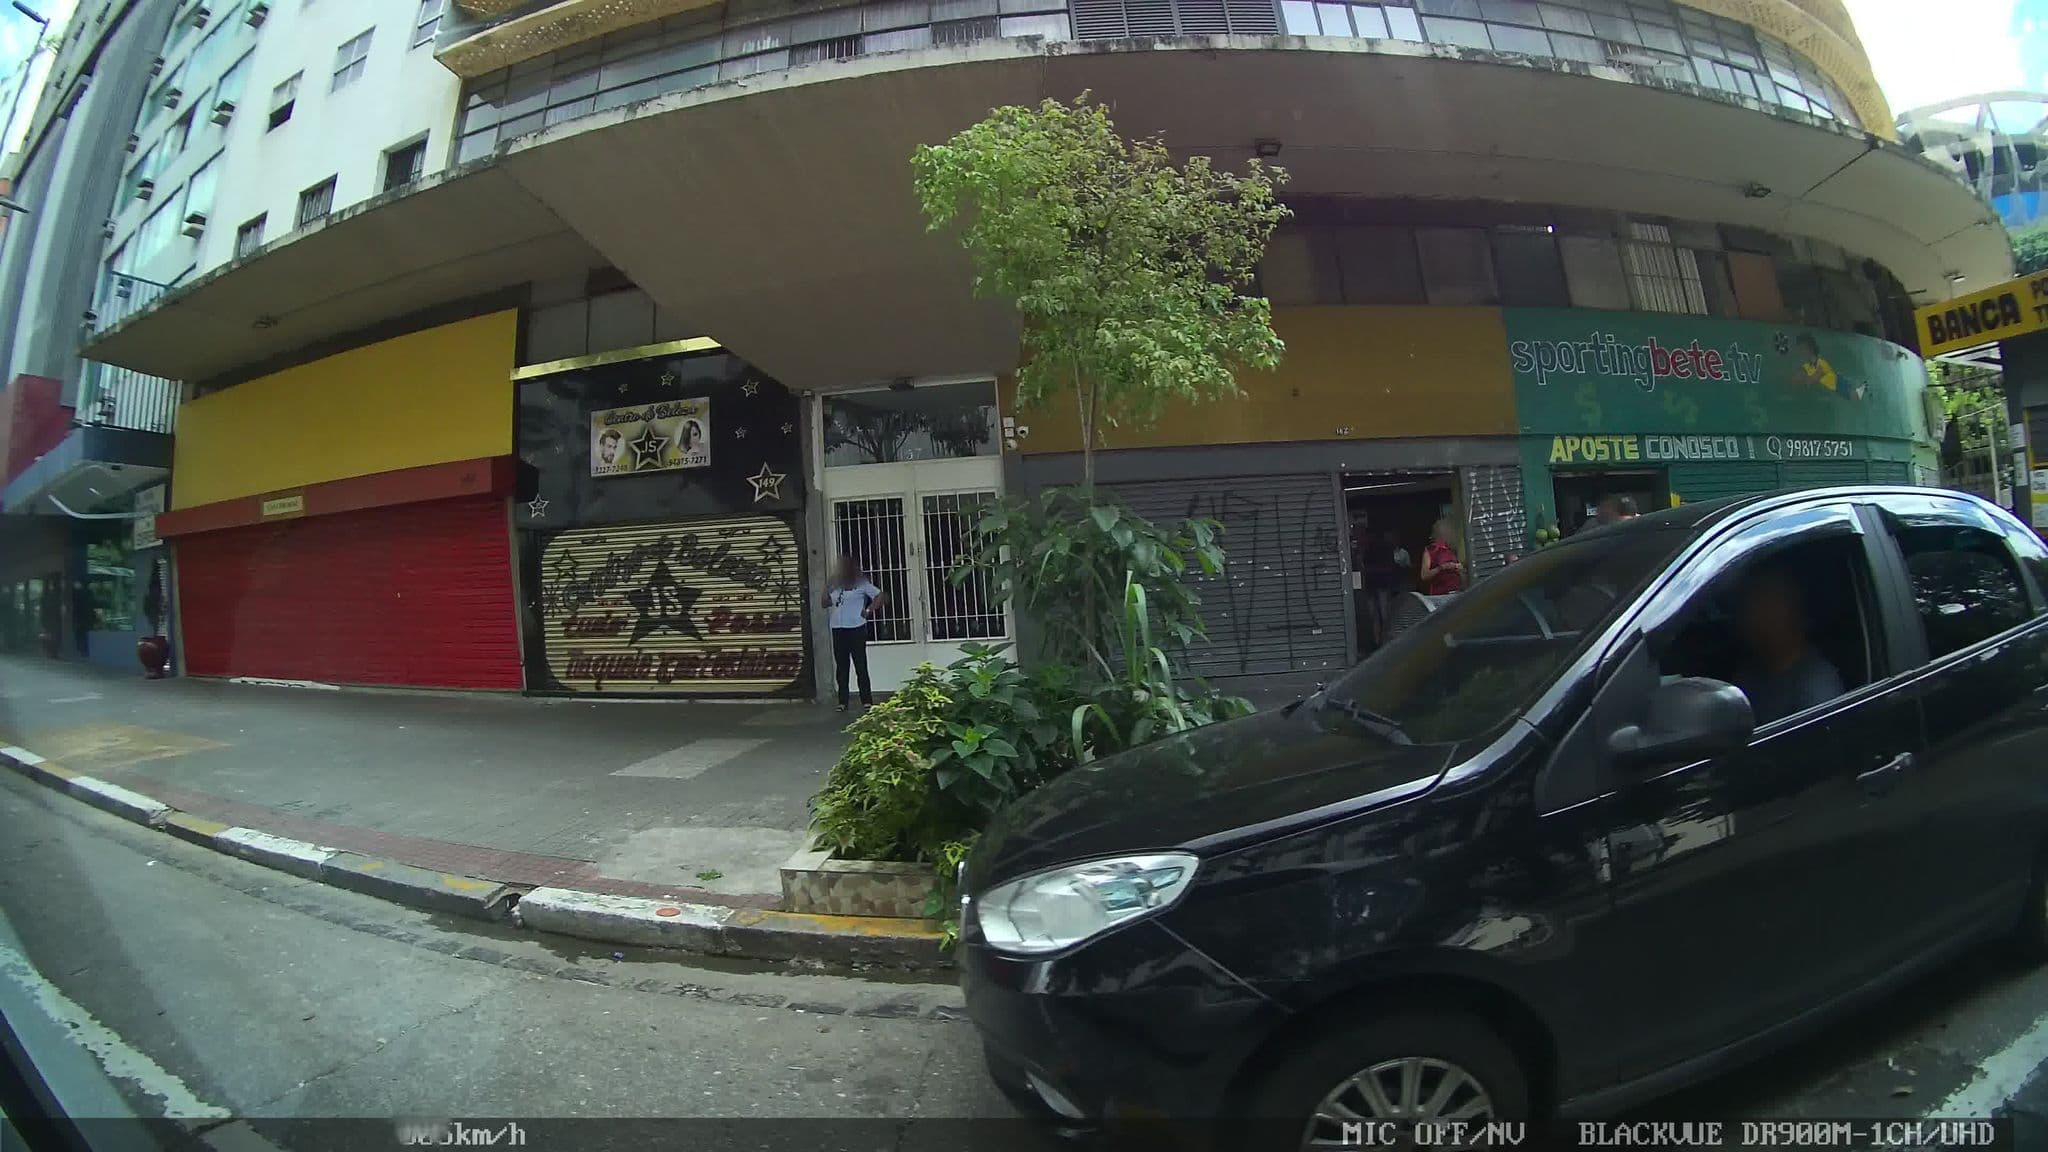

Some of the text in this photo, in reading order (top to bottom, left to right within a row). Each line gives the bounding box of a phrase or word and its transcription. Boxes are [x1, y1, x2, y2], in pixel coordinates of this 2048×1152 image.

[1928, 293, 2021, 345] BANCA
[1511, 331, 1761, 392] sportingbete.tv
[640, 441, 657, 453] JS
[1549, 434, 1640, 463] APOSTE
[1645, 435, 1740, 459] CONOSCO
[759, 477, 776, 488] 149
[648, 586, 682, 616] JS
